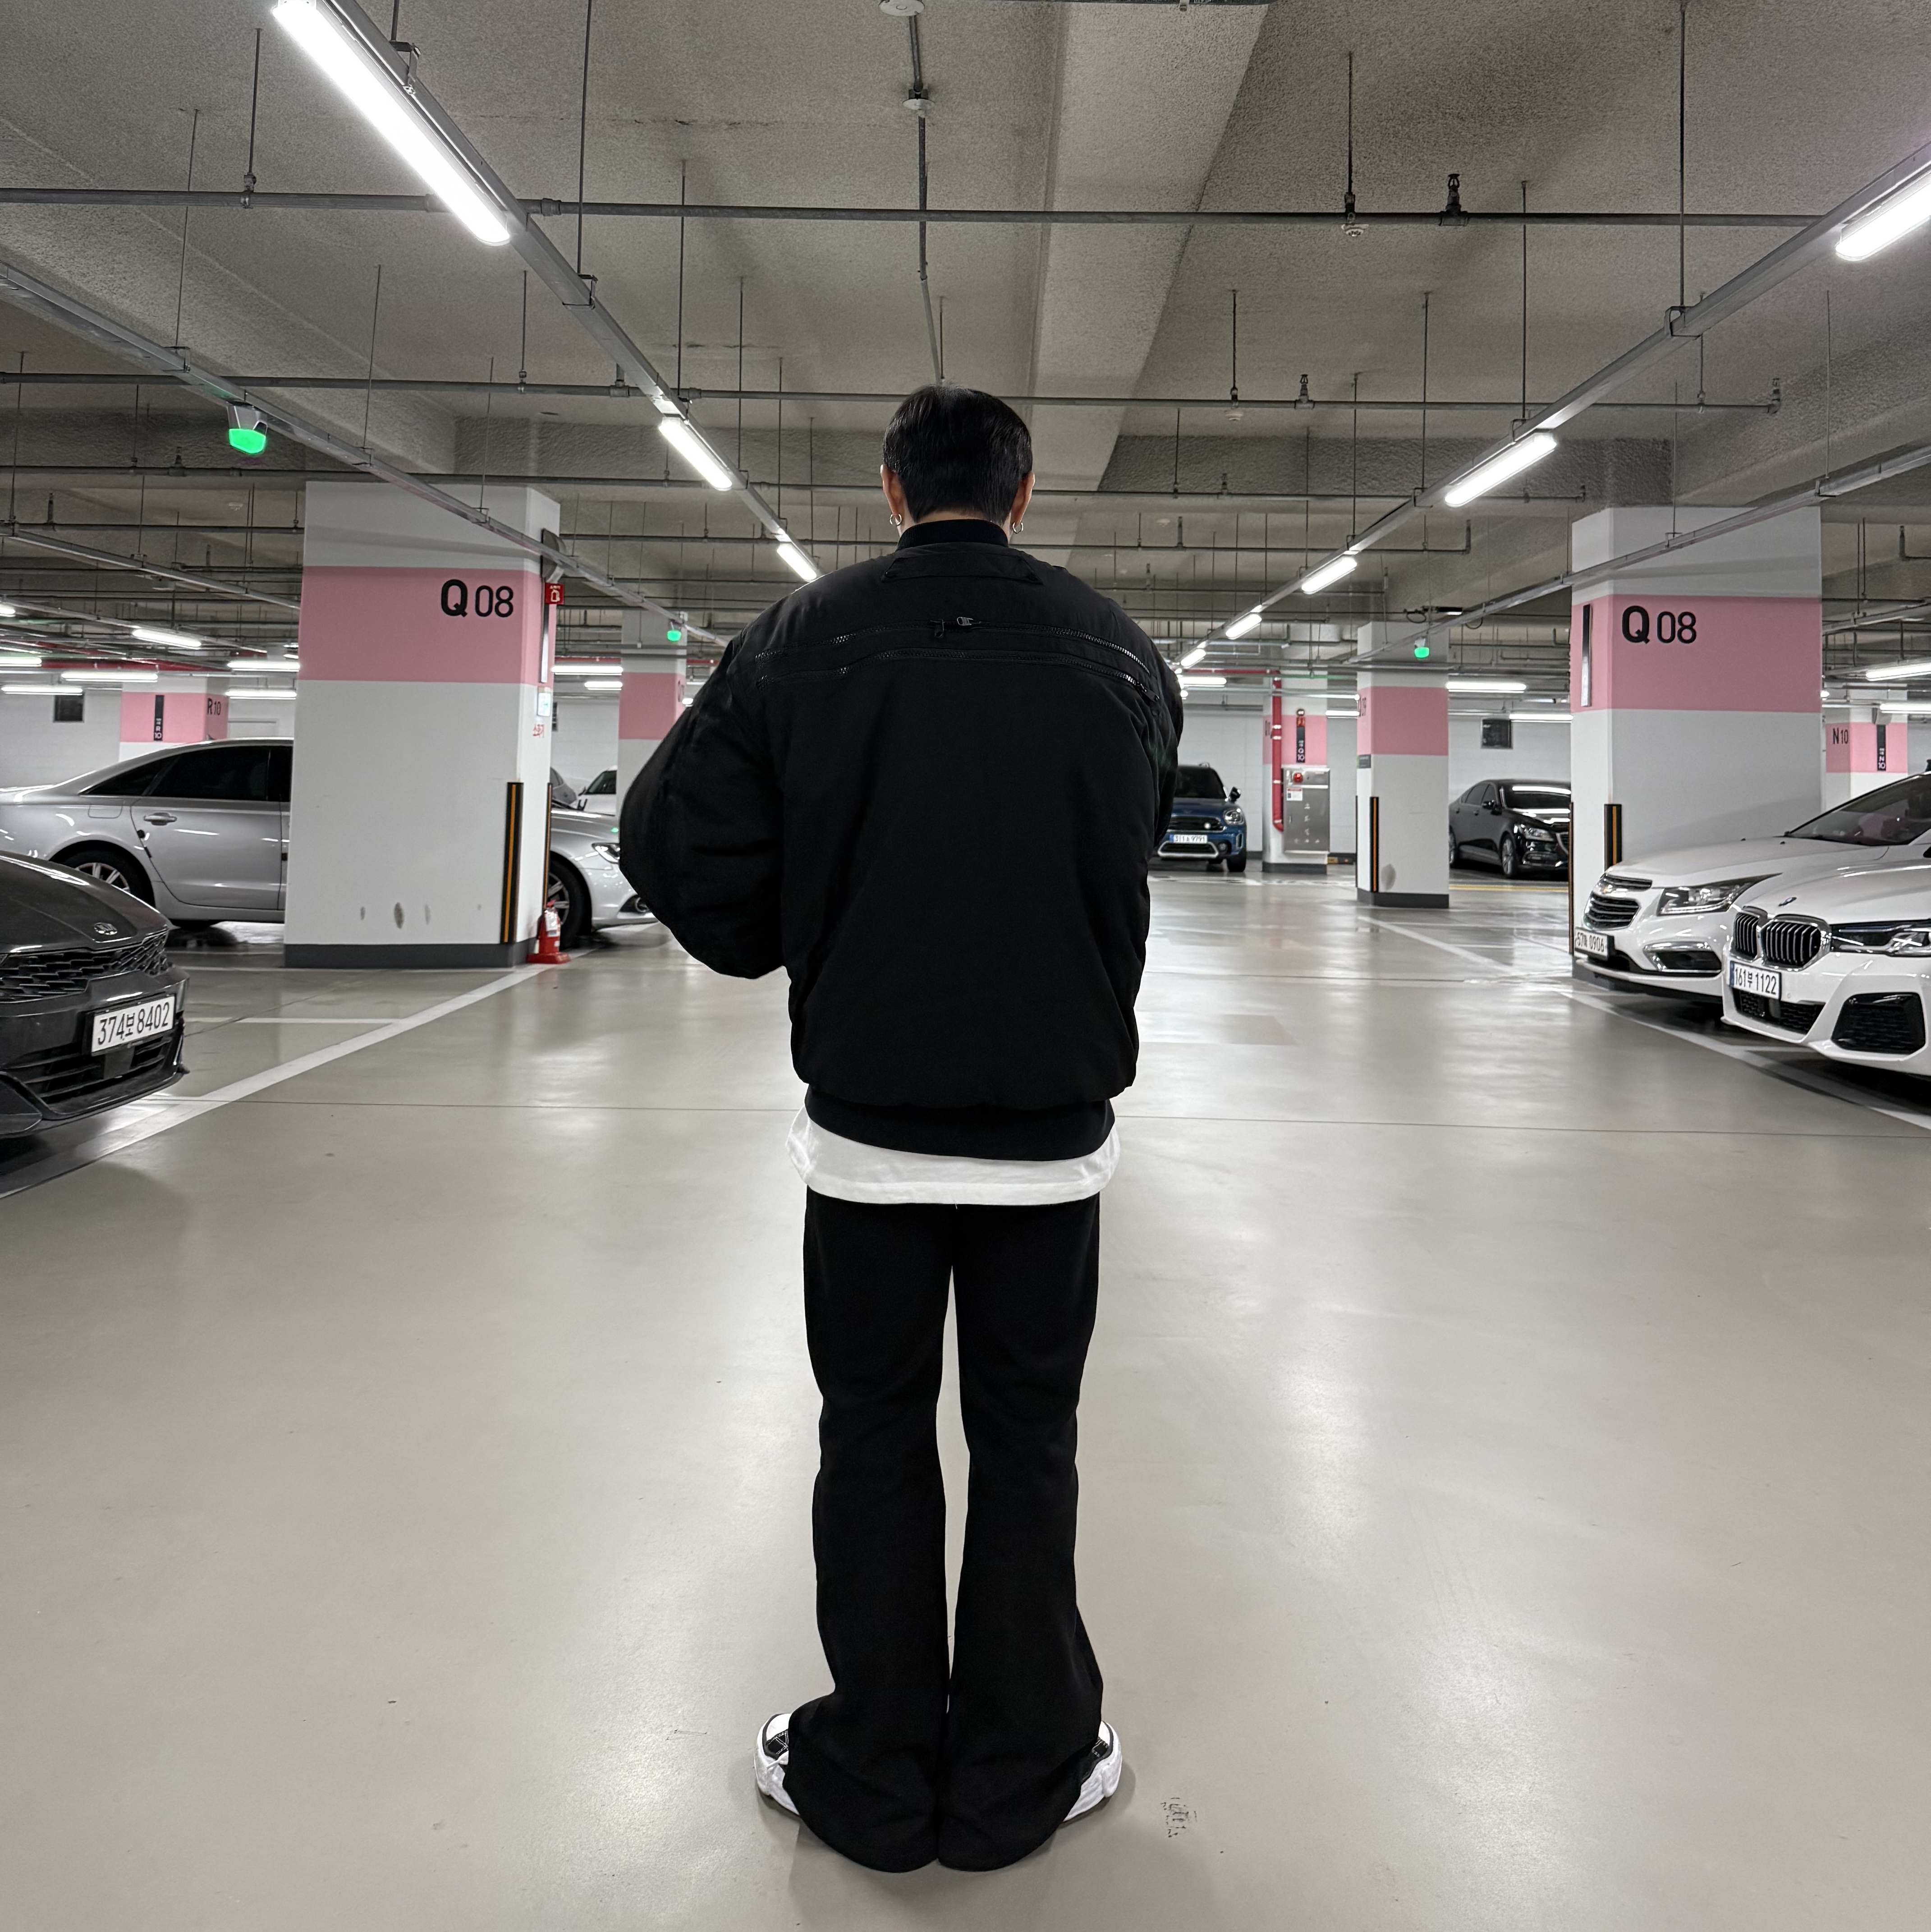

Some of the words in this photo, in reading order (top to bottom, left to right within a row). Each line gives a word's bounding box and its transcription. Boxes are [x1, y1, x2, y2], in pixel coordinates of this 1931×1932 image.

[441, 579, 468, 617] Q
[475, 585, 514, 618] 08
[1622, 606, 1650, 644] Q
[1657, 611, 1697, 644] 08
